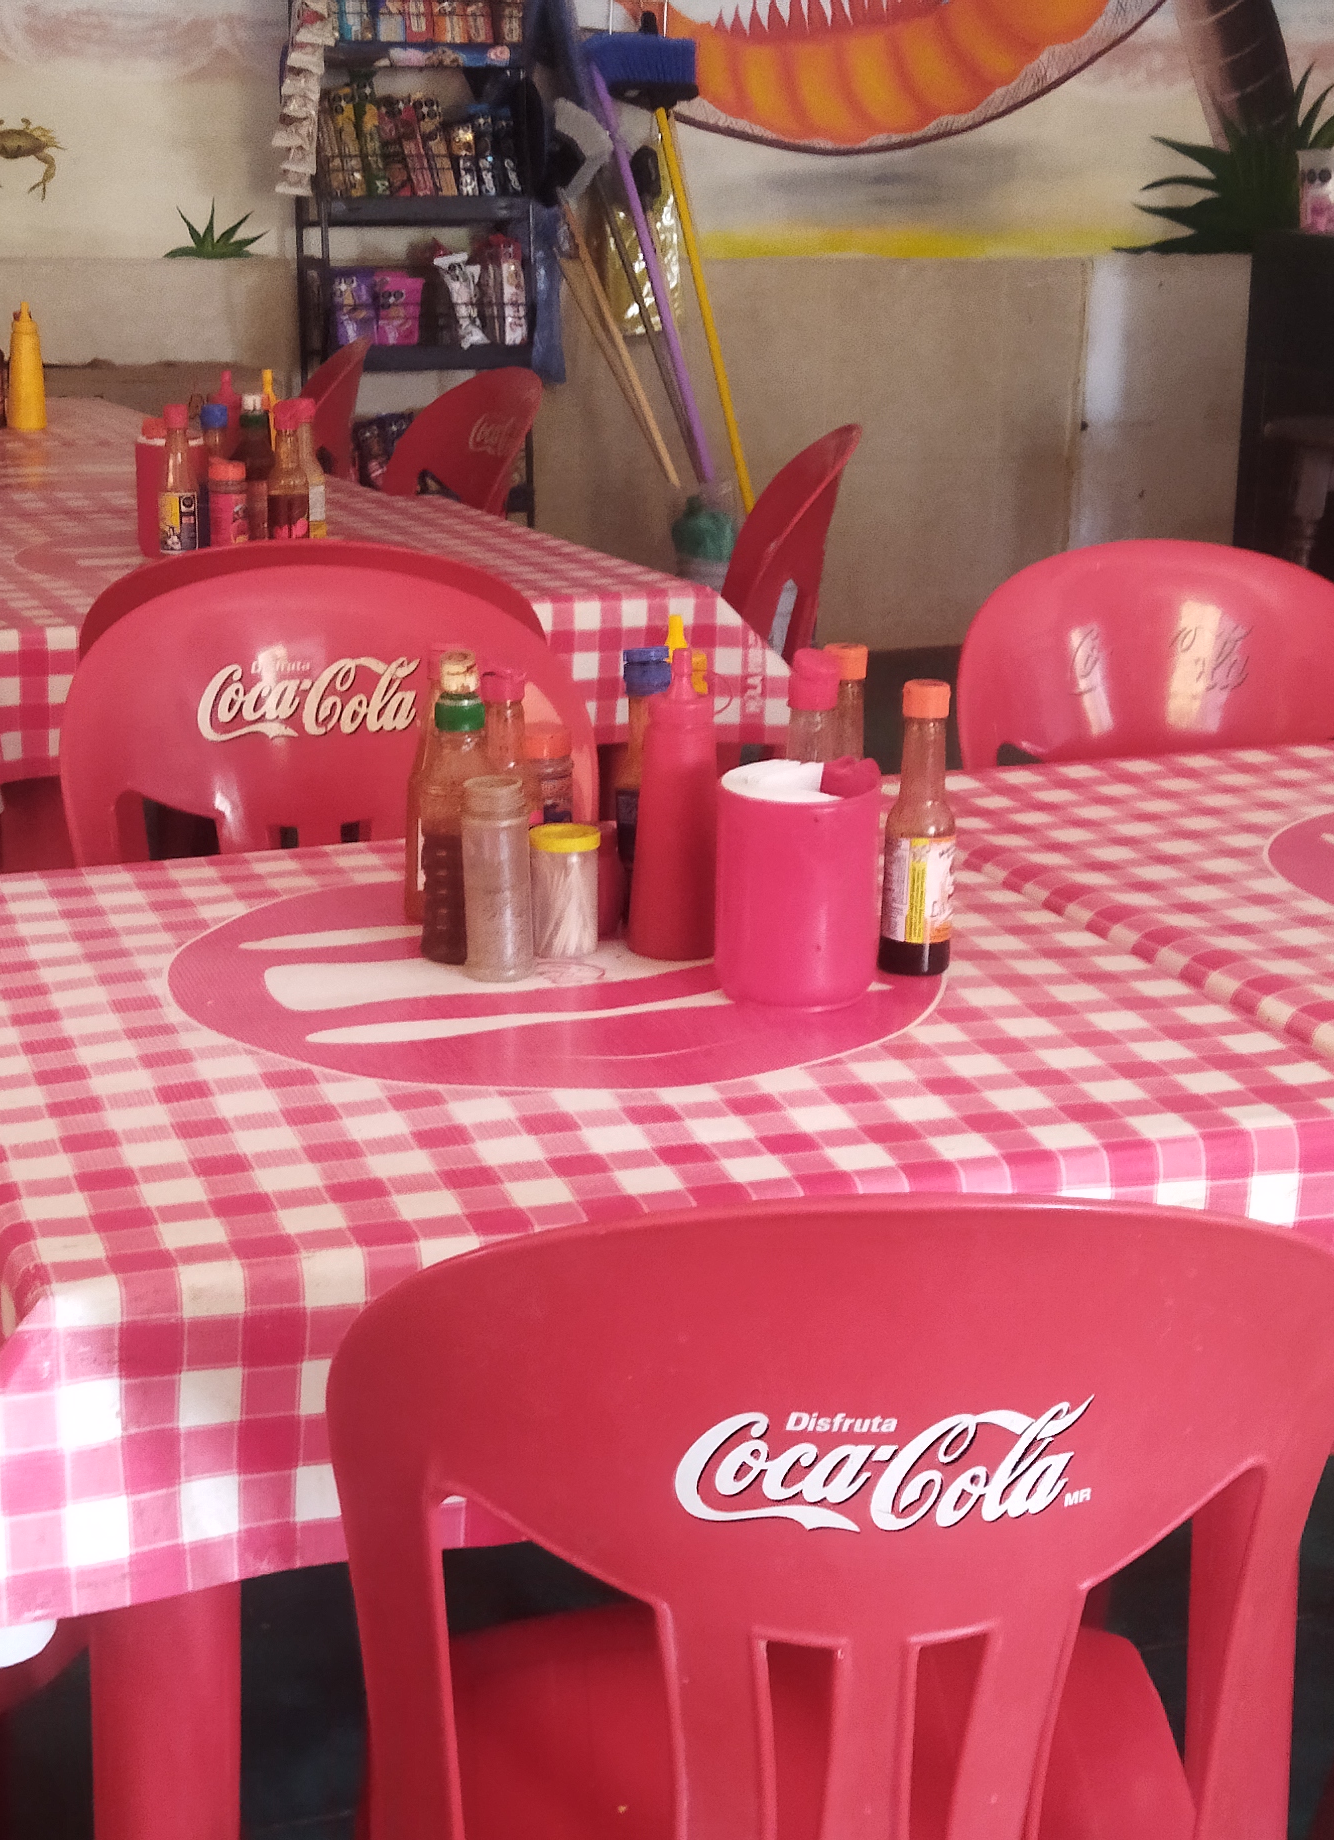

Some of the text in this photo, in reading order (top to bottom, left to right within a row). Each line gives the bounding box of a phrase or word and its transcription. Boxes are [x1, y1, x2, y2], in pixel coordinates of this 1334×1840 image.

[197, 656, 421, 742] Coca-Cola
[674, 1394, 1095, 1533] Coca-Cola
[785, 1411, 898, 1433] Disfruta
